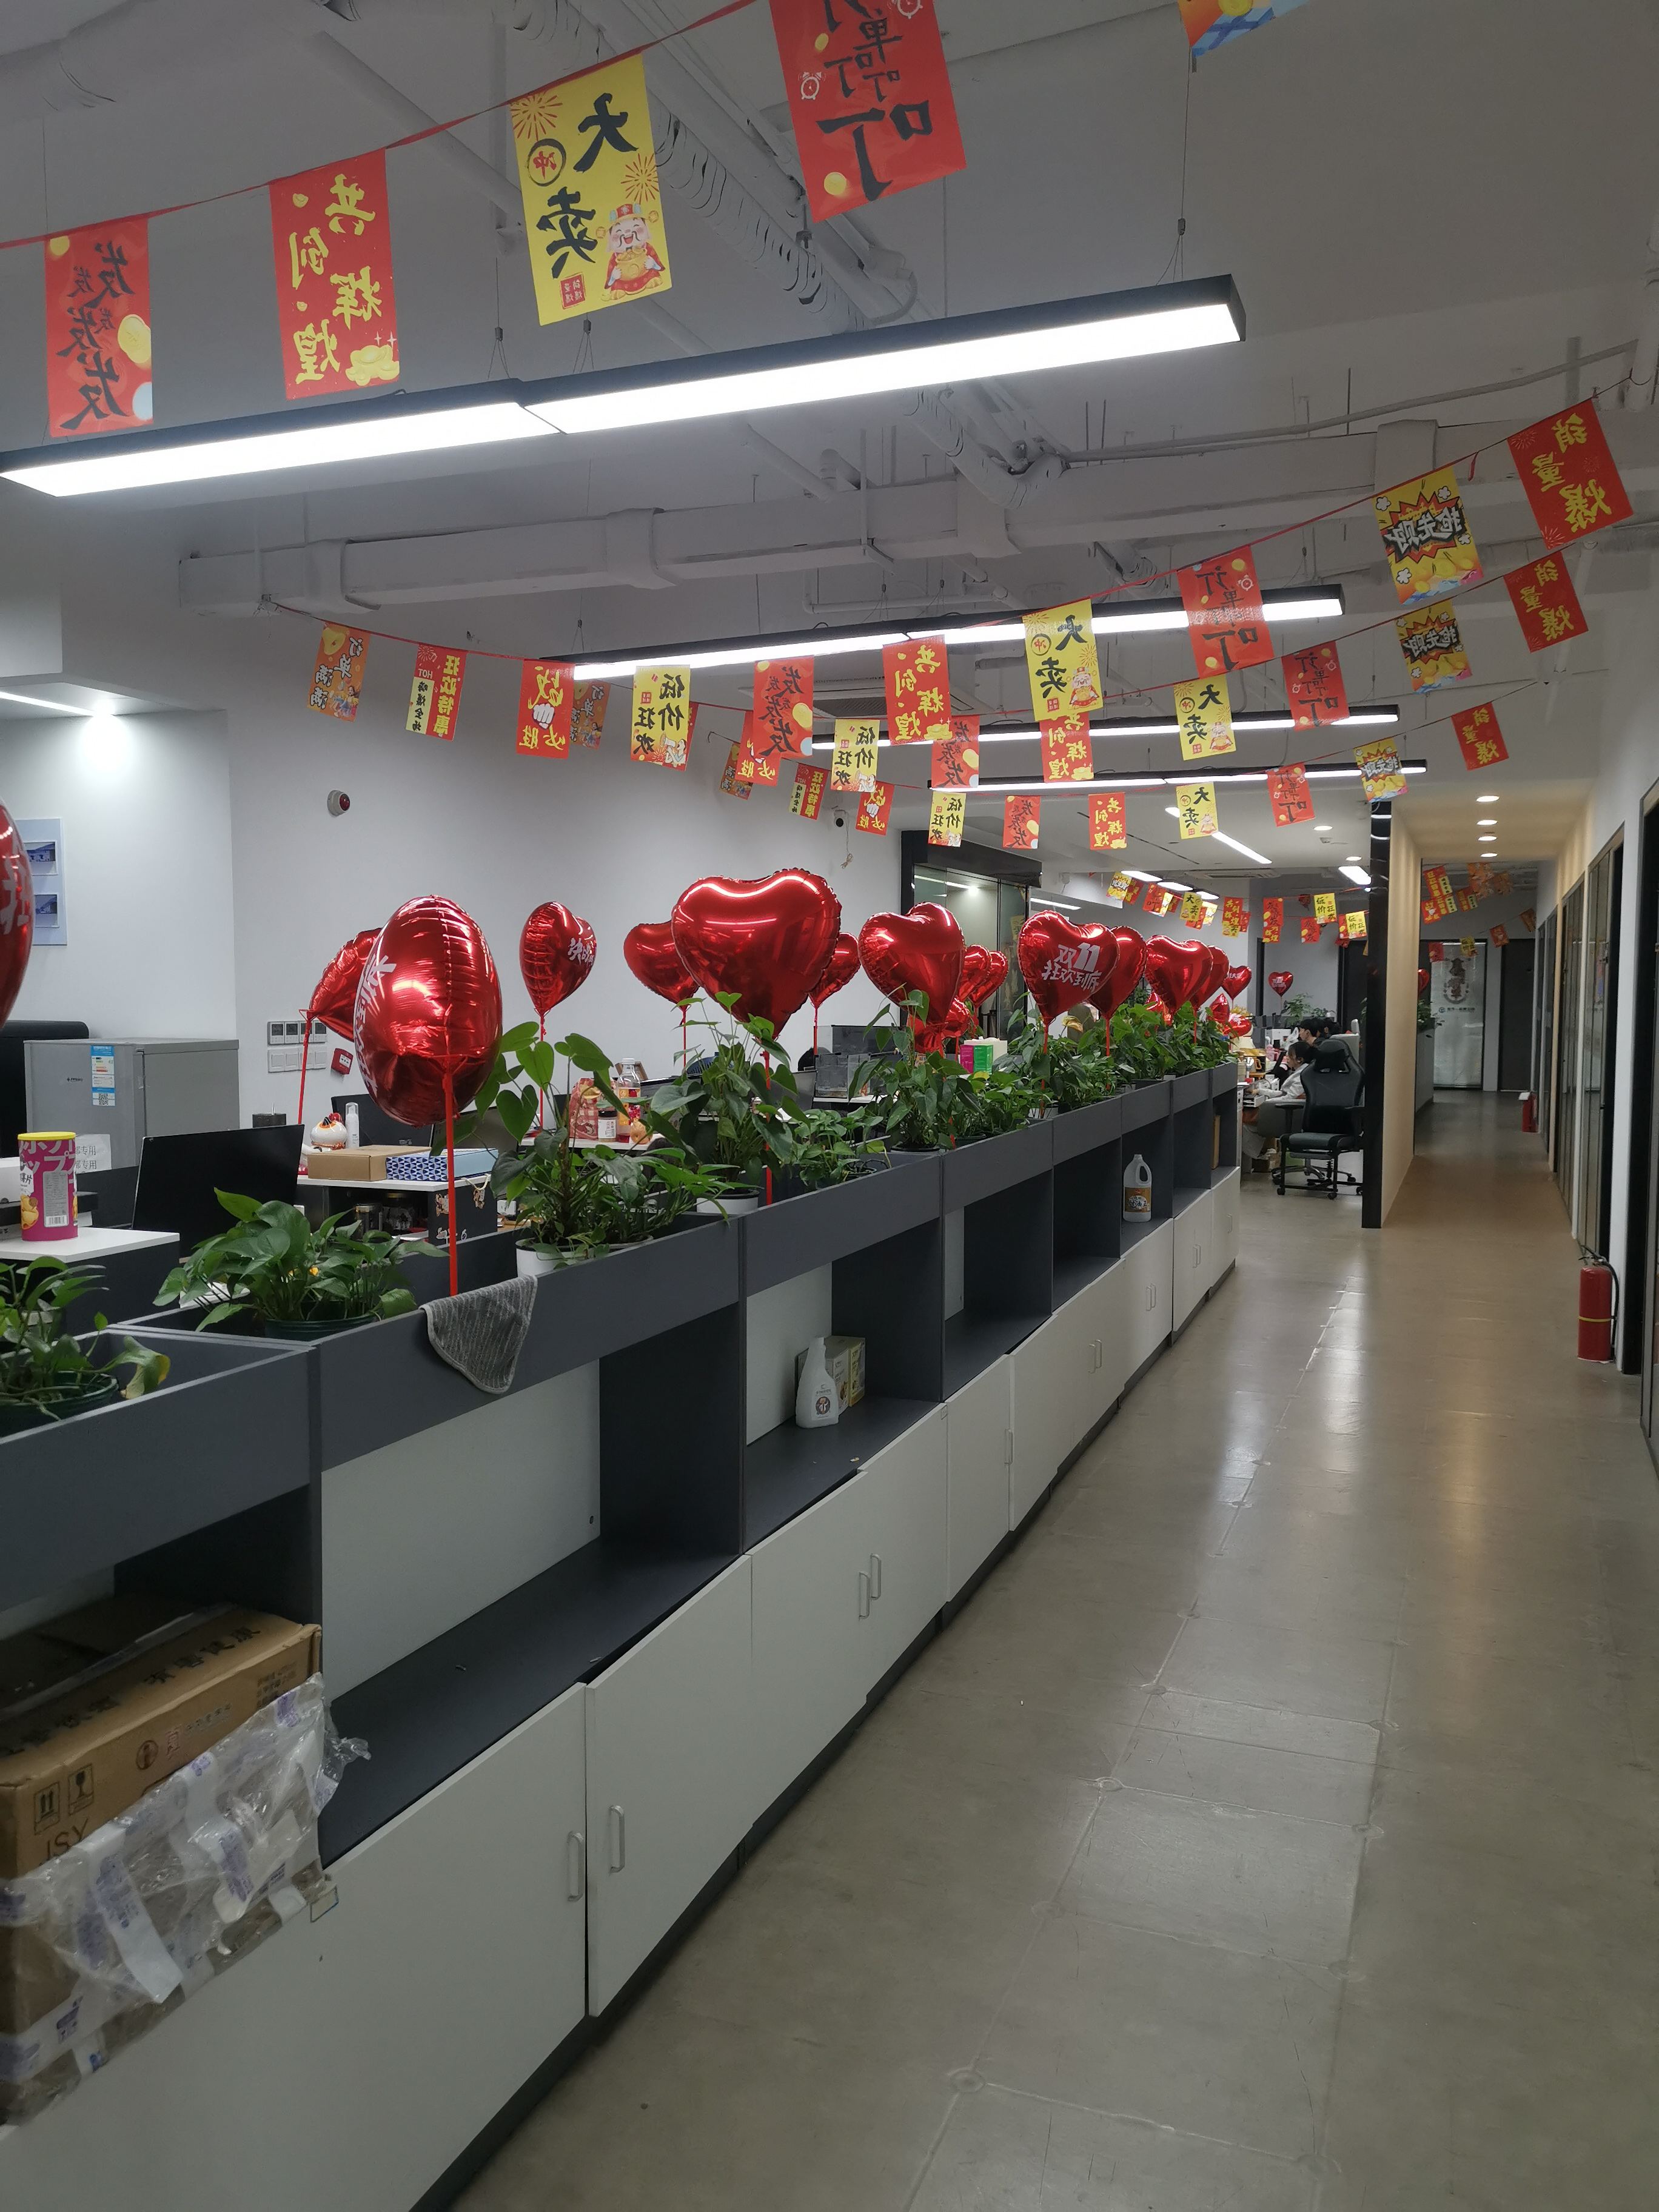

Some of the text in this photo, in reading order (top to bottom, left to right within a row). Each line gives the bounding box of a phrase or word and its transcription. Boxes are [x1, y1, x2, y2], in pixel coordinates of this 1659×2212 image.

[1054, 942, 1101, 972] 双11
[1042, 960, 1101, 990] 狂欢到底
